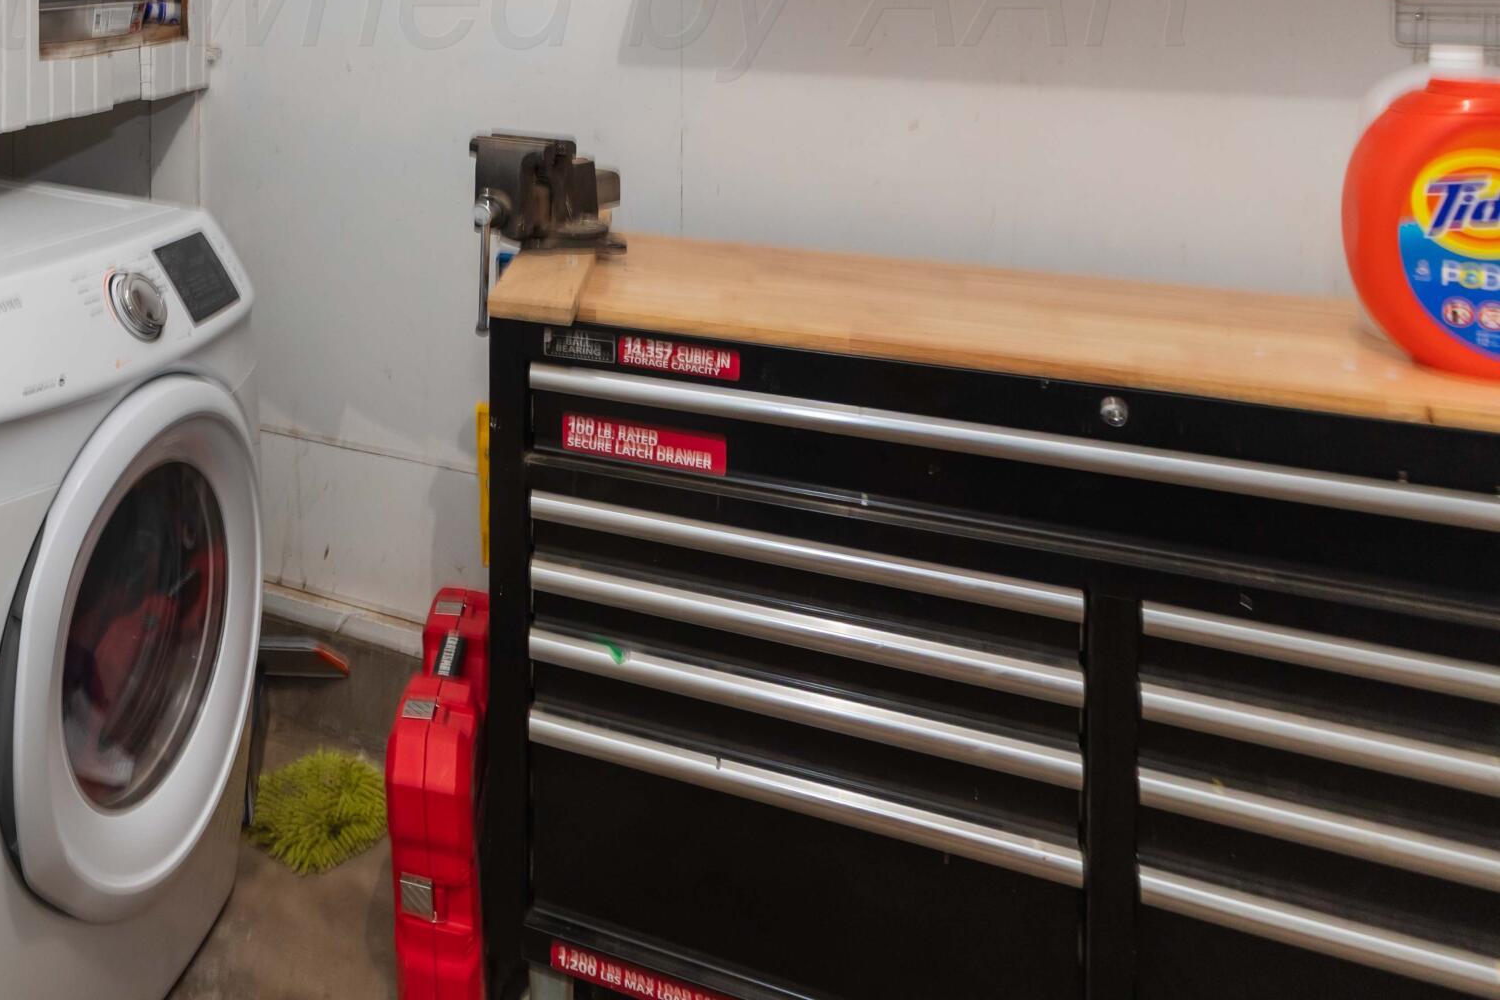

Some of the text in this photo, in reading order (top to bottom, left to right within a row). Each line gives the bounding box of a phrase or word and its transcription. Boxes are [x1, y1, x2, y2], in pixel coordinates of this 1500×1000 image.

[556, 344, 601, 357] BEARING
[676, 351, 715, 367] CUBIC
[717, 355, 731, 369] IN
[623, 355, 669, 369] STORAGE
[671, 362, 721, 376] CAPACITY
[568, 420, 658, 446] 100 LB. RATED
[567, 437, 712, 470] SECURE LATCH DRAWER
[558, 953, 597, 978] 1,200
[600, 969, 622, 986] LBS
[625, 978, 654, 998] MAX
